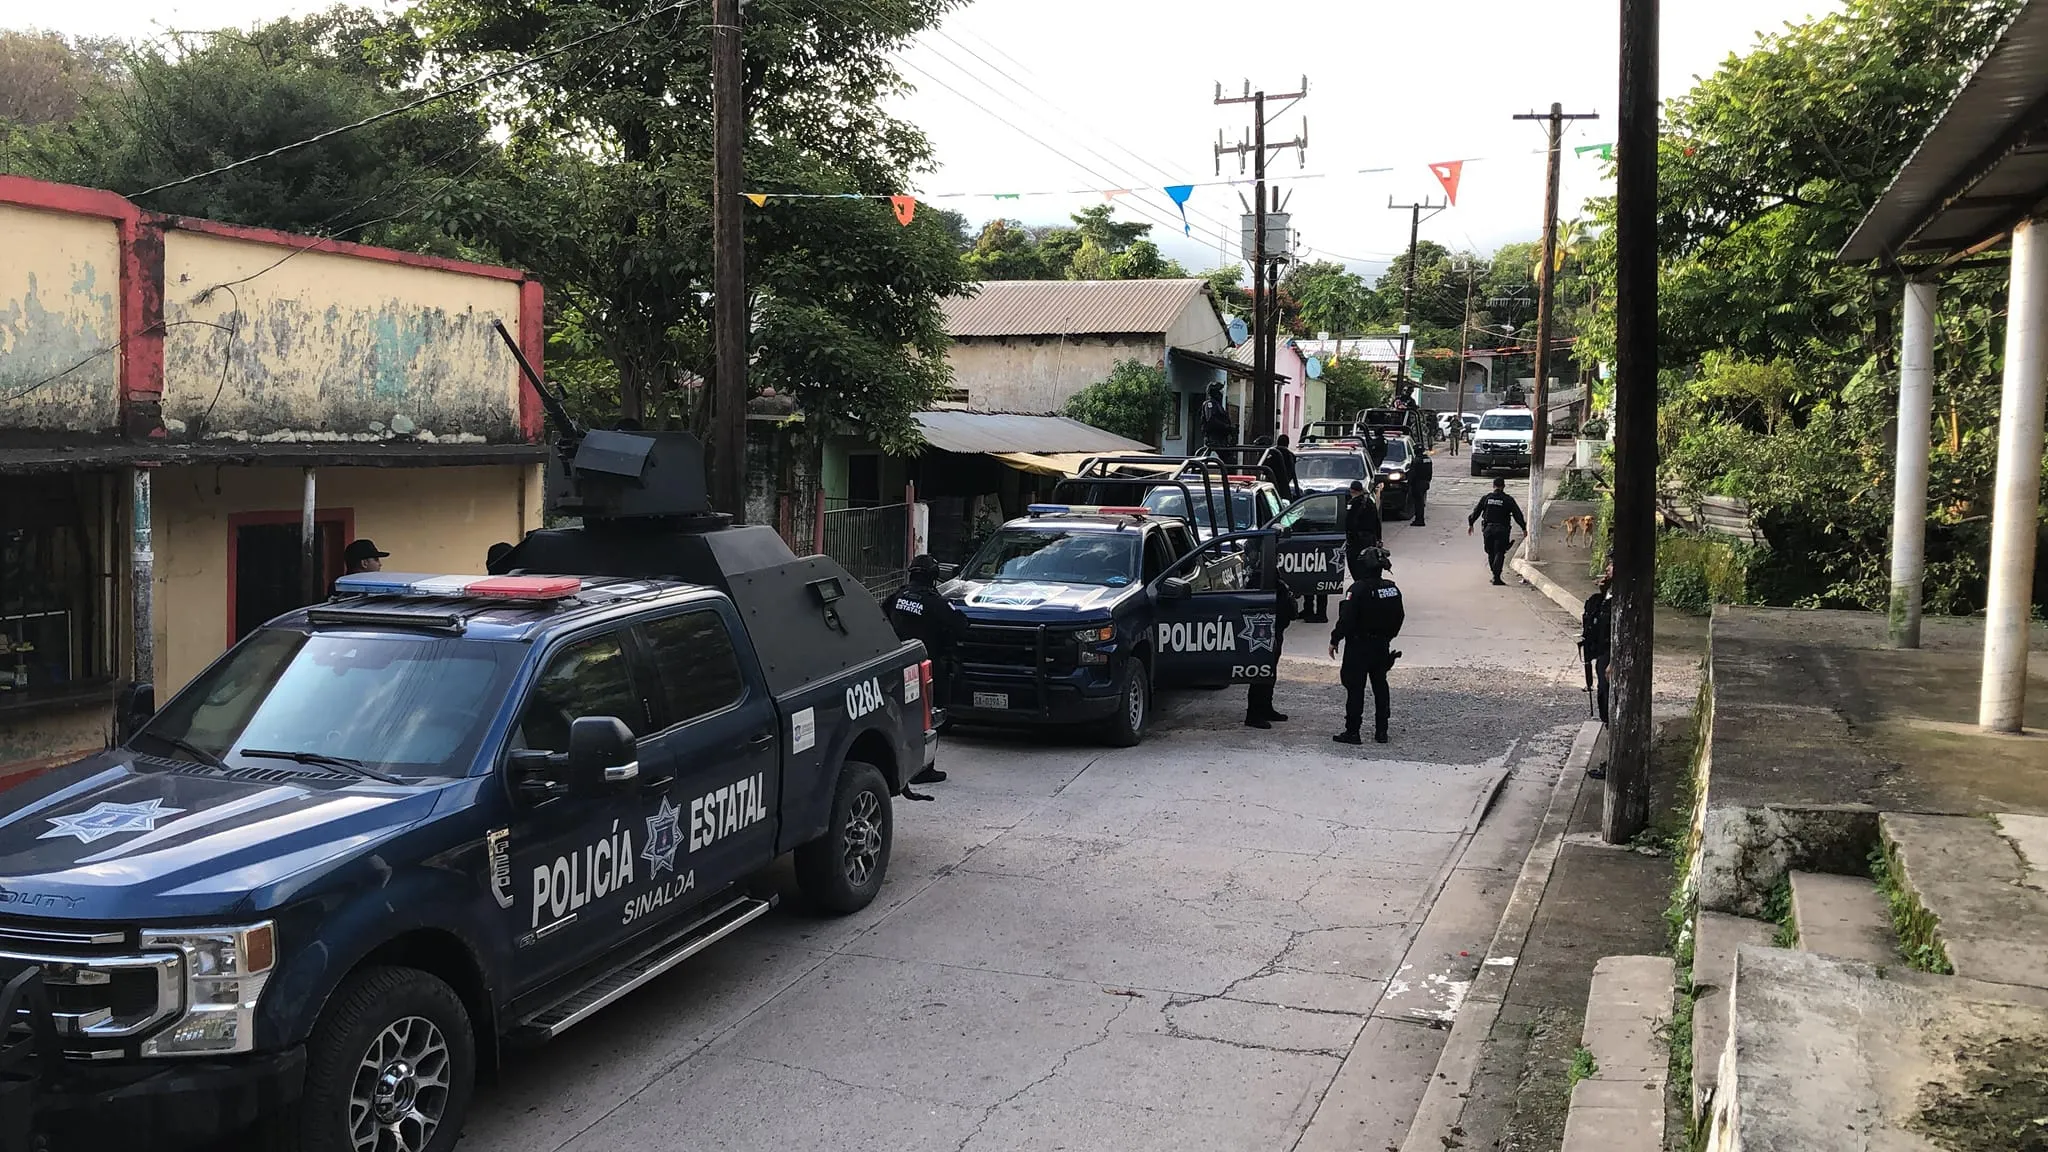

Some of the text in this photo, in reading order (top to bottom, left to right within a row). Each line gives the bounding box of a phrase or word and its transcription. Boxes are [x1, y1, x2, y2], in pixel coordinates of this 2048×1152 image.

[1158, 615, 1236, 653] POLICÍA
[1231, 664, 1274, 678] ROS
[846, 677, 884, 720] 028A
[532, 772, 767, 928] POLICÍA ESTATAL
[622, 869, 695, 925] SINALOA
